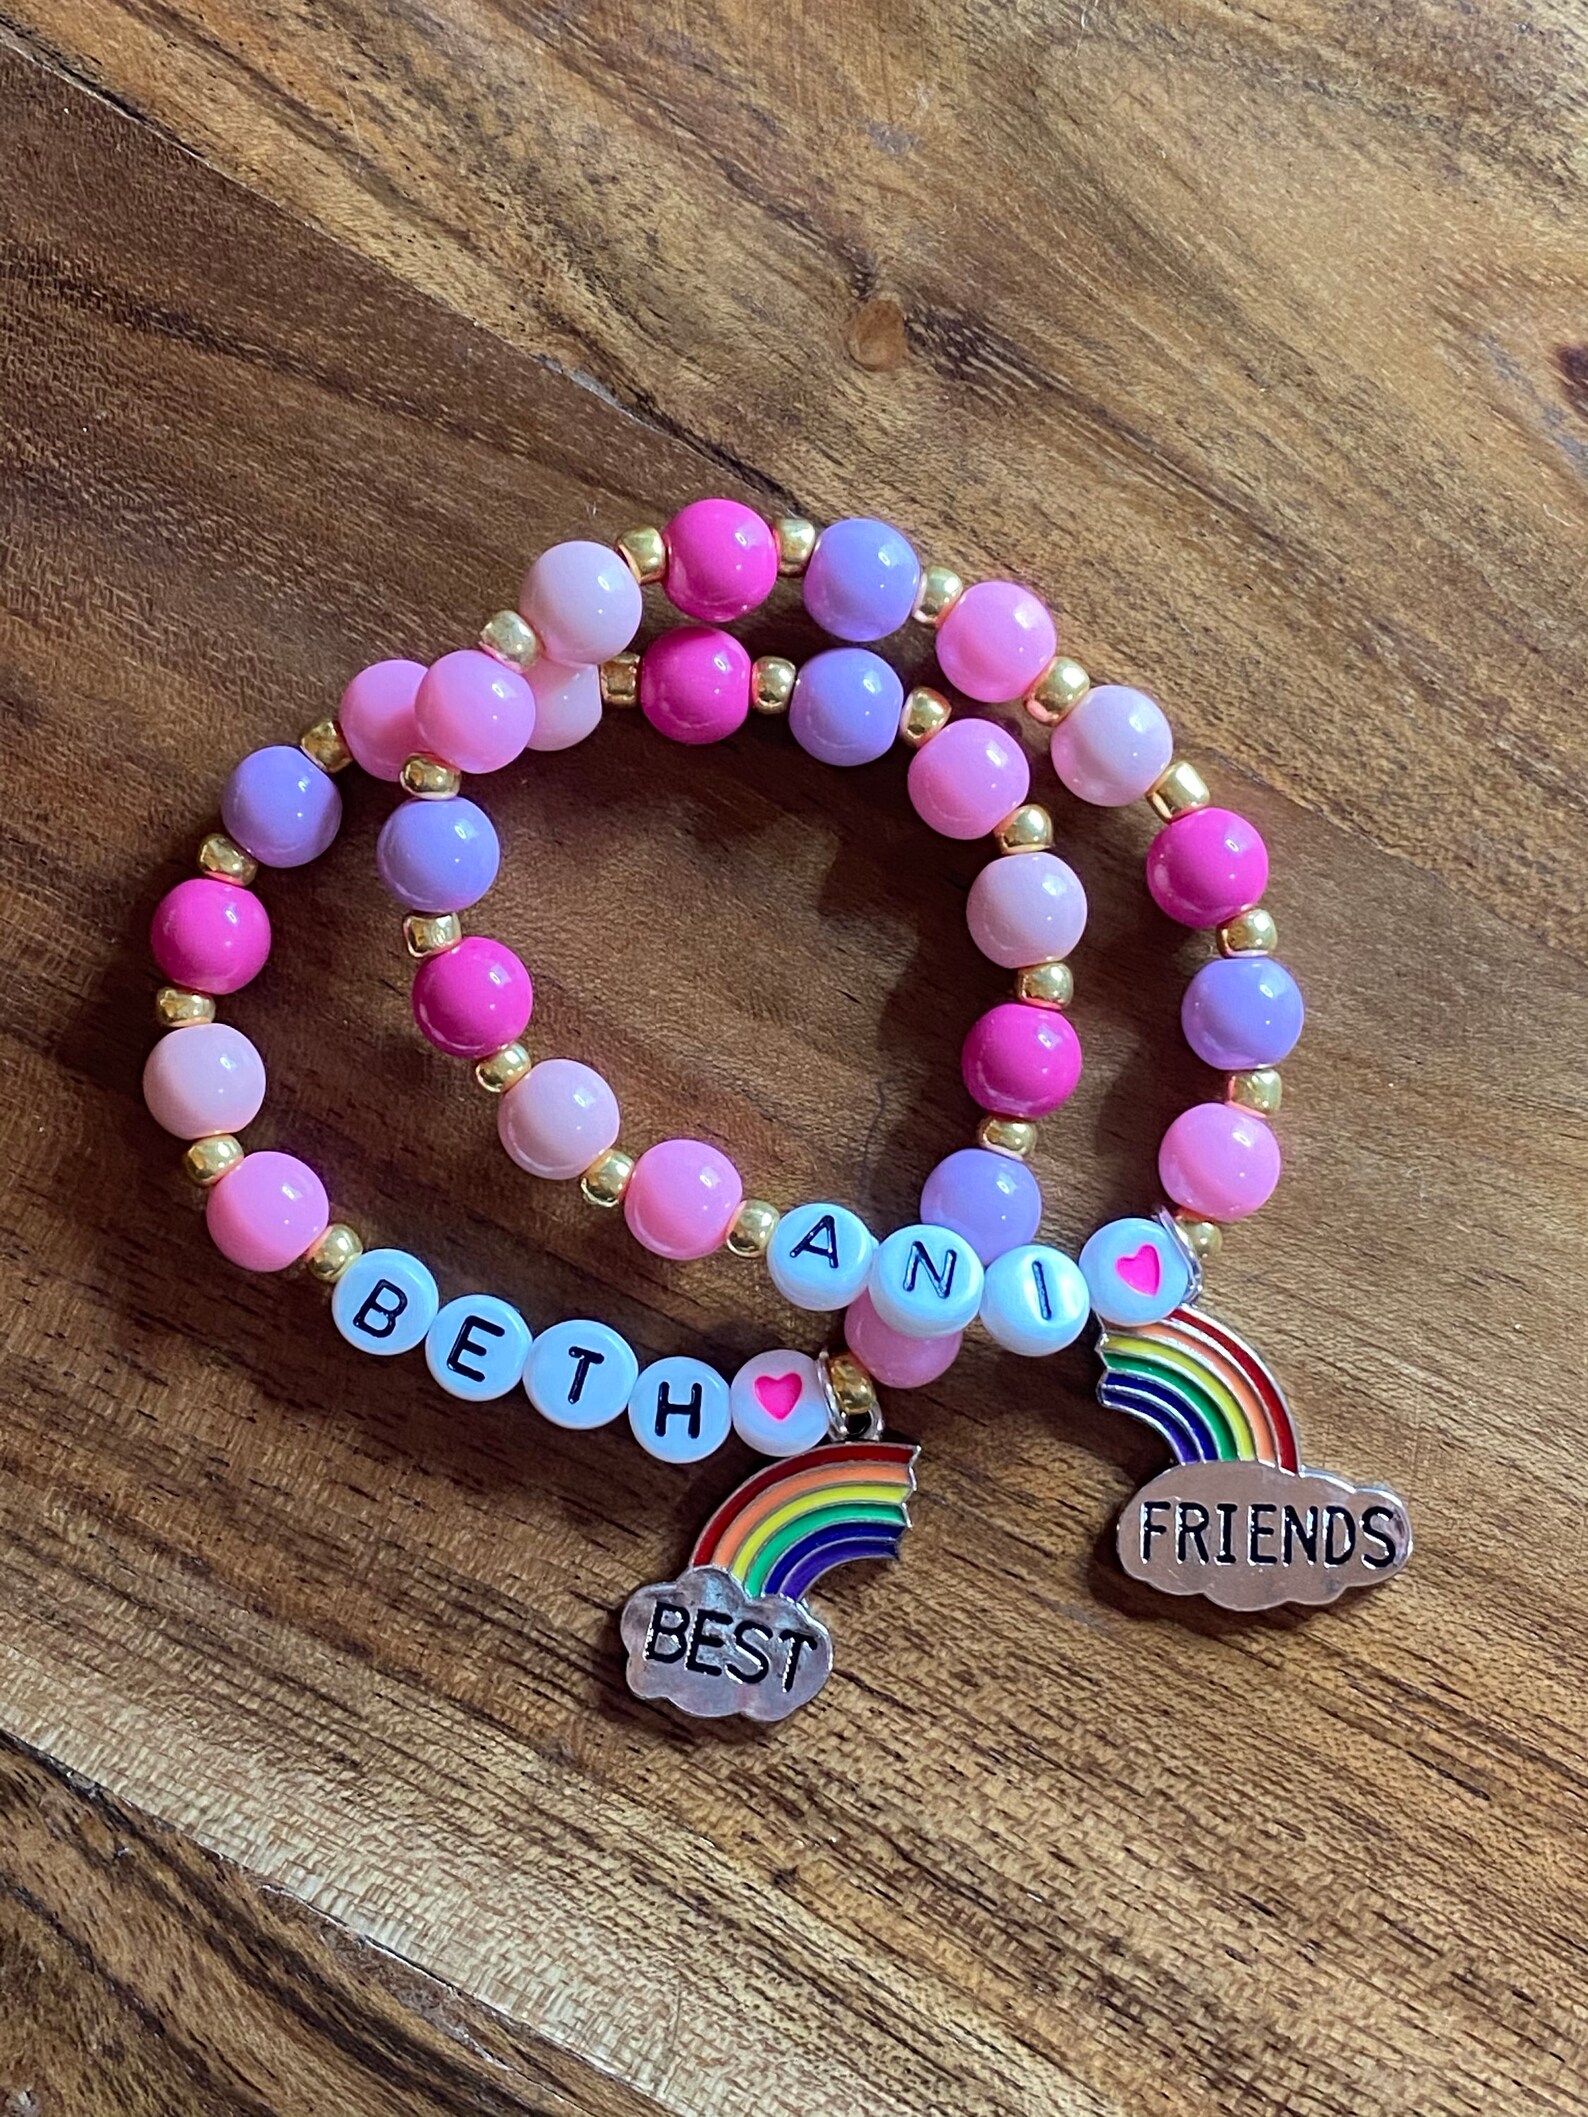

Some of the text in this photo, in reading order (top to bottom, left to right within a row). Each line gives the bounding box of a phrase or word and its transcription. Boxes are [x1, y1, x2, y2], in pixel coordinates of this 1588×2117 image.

[789, 1214, 1053, 1321] ANI
[351, 1278, 703, 1440] BETH
[1140, 1501, 1398, 1570] FRIENDS
[643, 1600, 819, 1693] BEST
